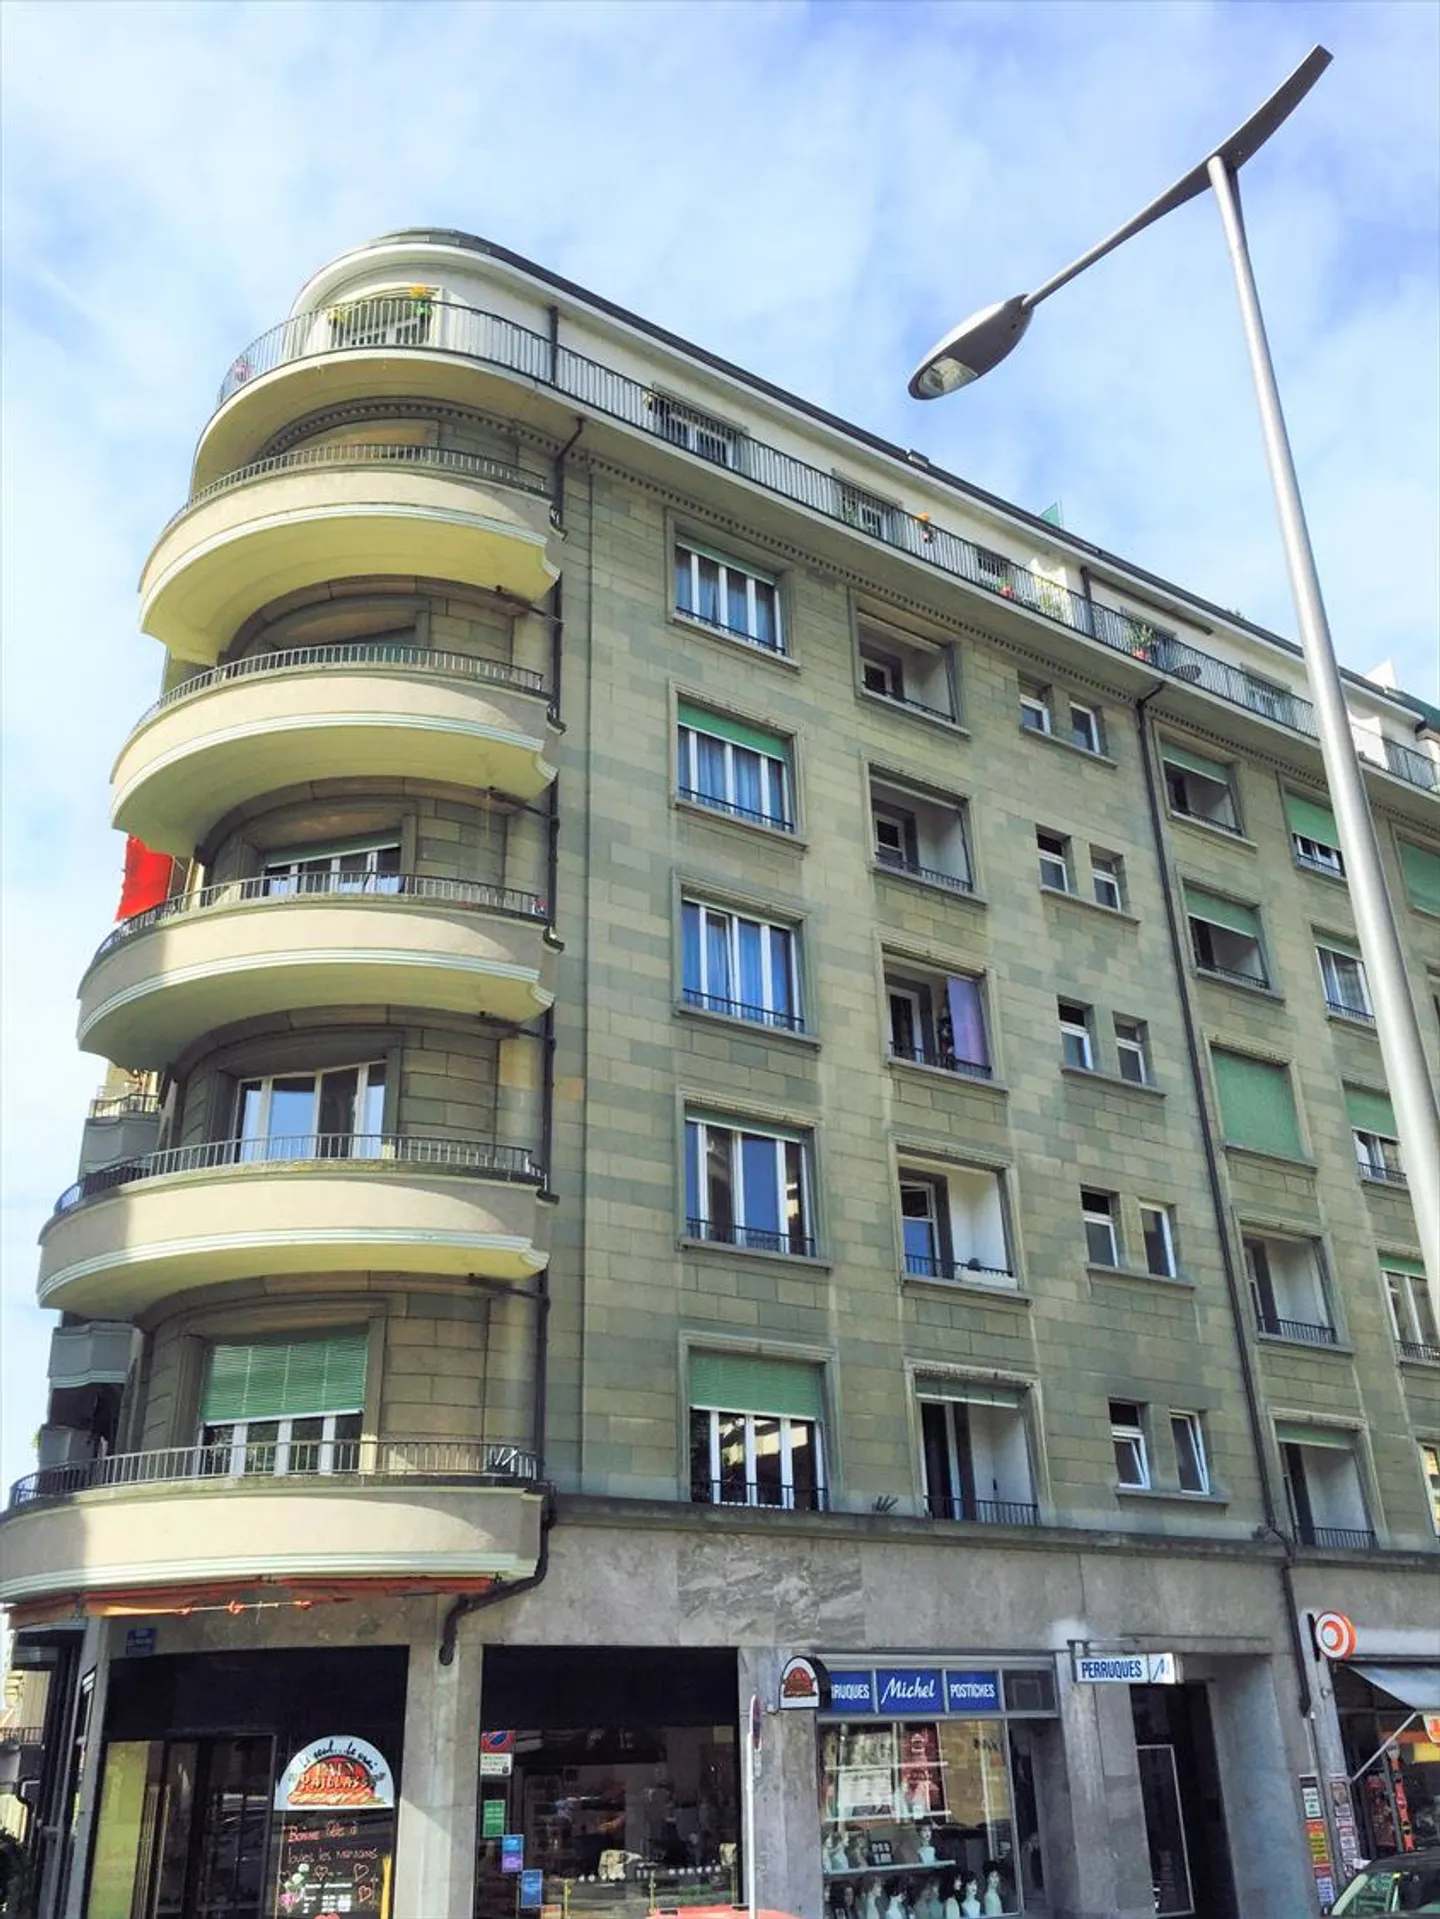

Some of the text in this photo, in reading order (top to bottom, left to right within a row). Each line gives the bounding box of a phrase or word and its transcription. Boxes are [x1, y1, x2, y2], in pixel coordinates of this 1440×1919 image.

[1081, 1660, 1142, 1679] PERRUQUES
[881, 1676, 936, 1705] Michel
[950, 1683, 996, 1698] POSTICHES
